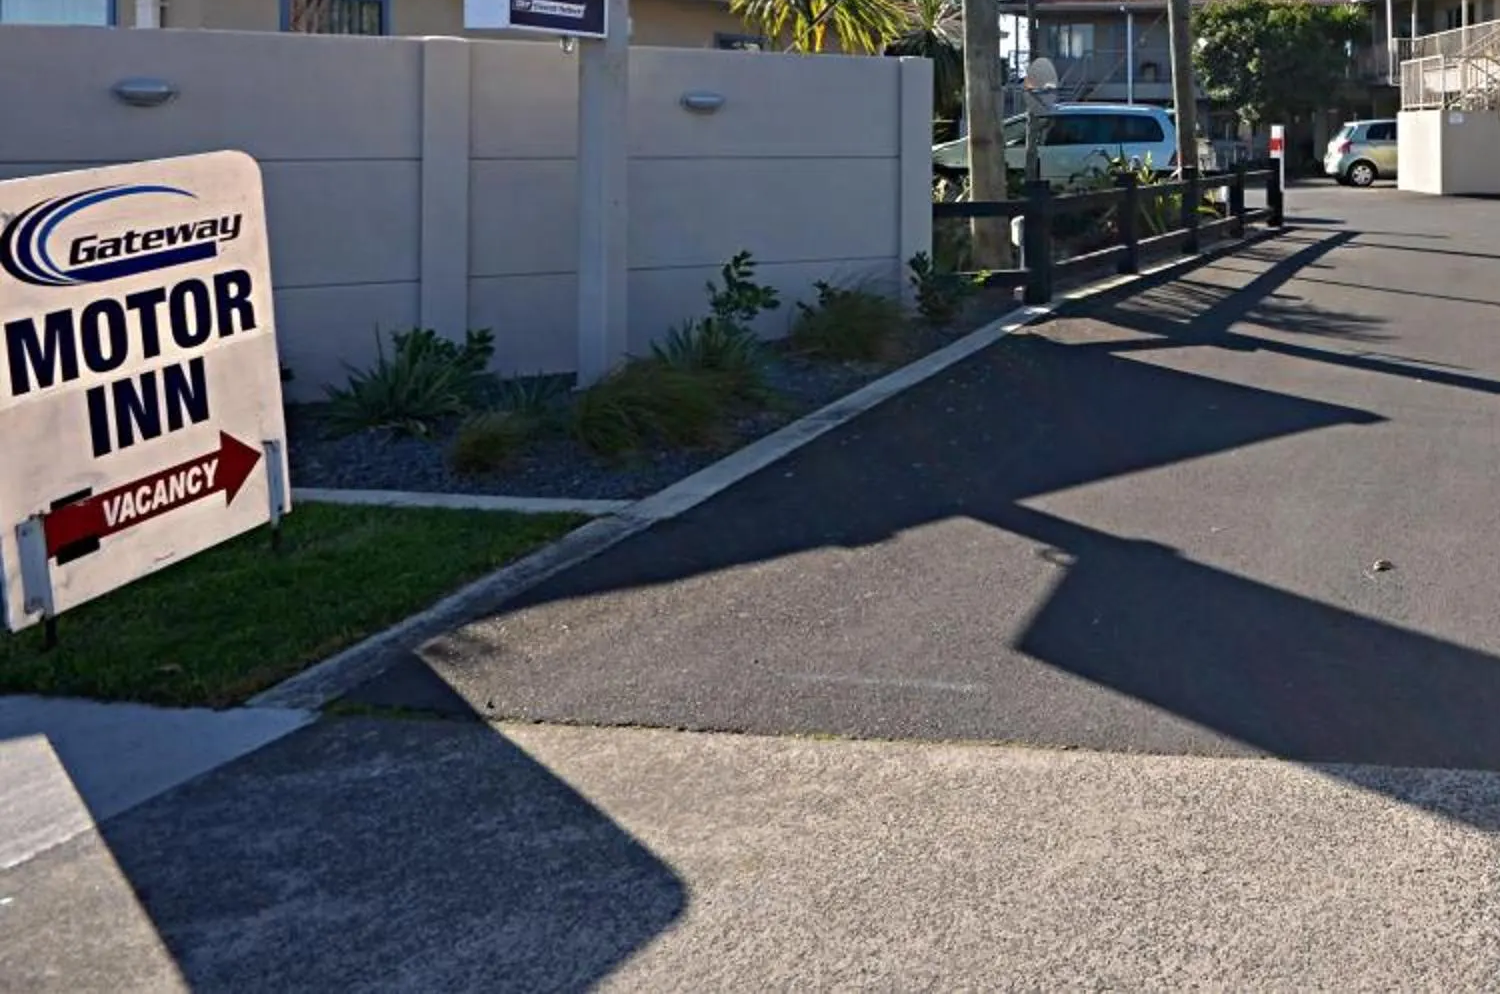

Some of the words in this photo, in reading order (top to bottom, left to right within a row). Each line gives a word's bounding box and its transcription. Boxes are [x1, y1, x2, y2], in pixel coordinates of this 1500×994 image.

[69, 213, 243, 267] Gateway
[4, 269, 257, 397] MOTOR
[86, 356, 210, 458] INN
[102, 458, 220, 528] VACANCY
